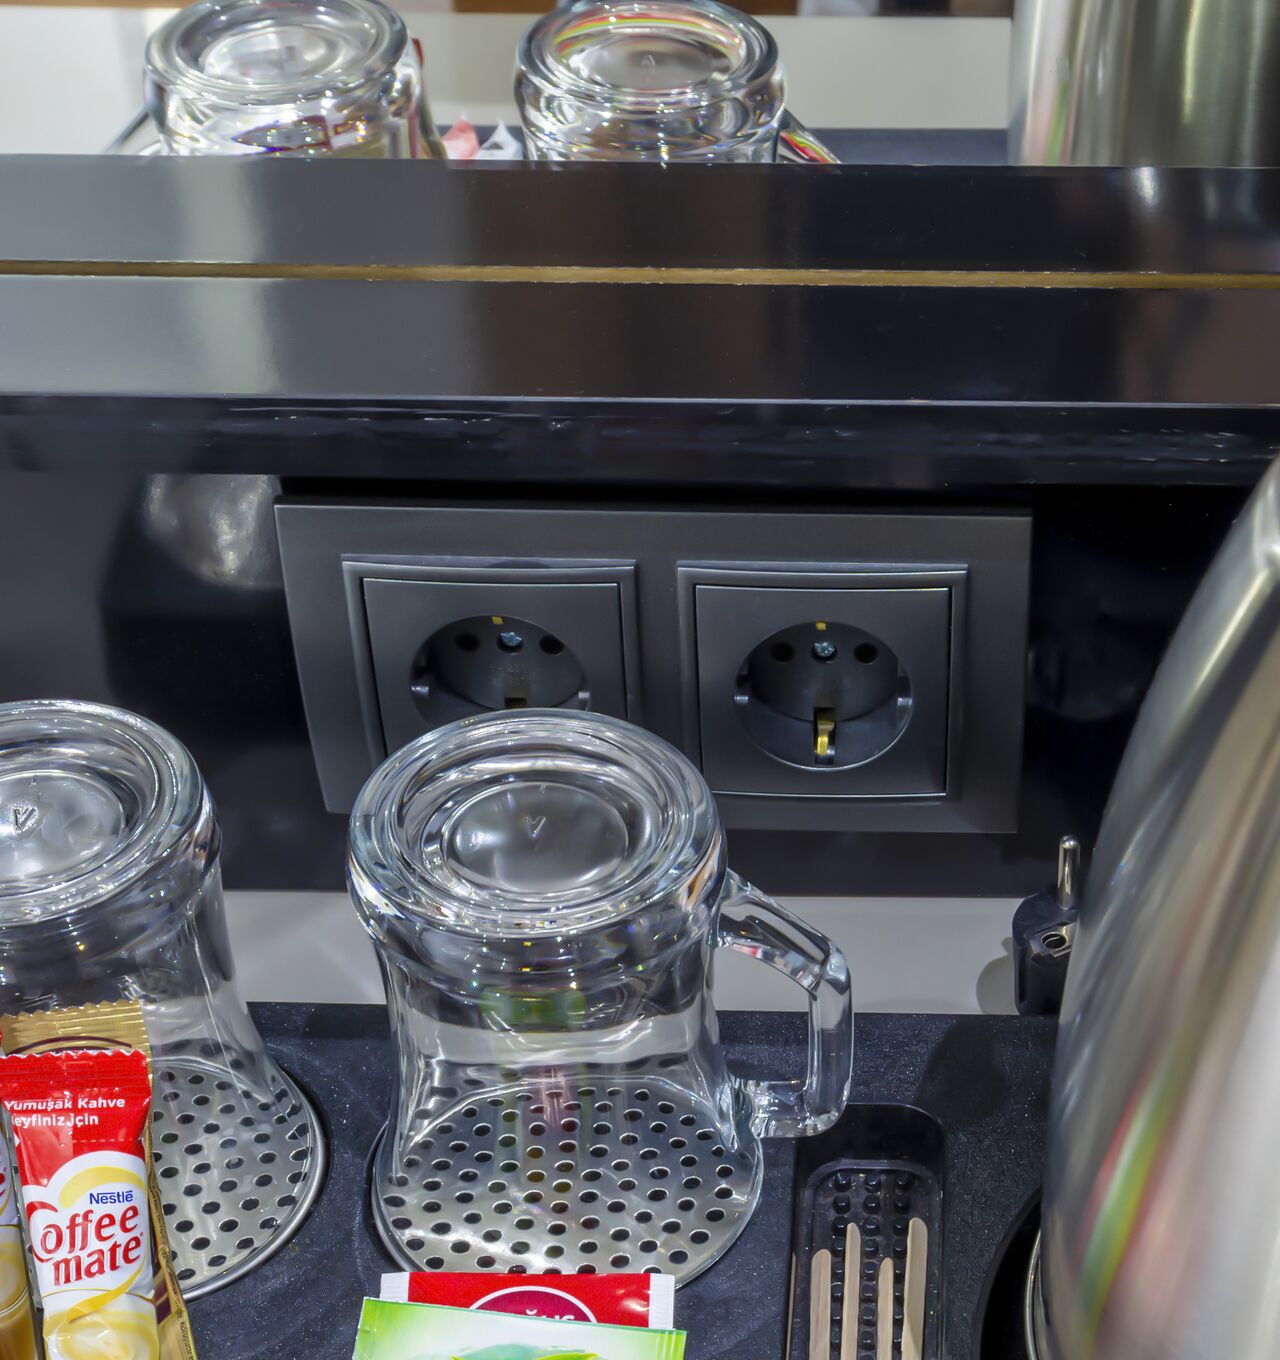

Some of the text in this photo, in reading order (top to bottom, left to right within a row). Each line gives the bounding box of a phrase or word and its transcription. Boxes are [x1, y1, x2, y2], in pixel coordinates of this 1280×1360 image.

[4, 1096, 126, 1112] Yumuşak Kahve
[11, 1113, 65, 1129] eyfiniz
[25, 1200, 140, 1264] Coffee
[52, 1232, 141, 1287] mate
